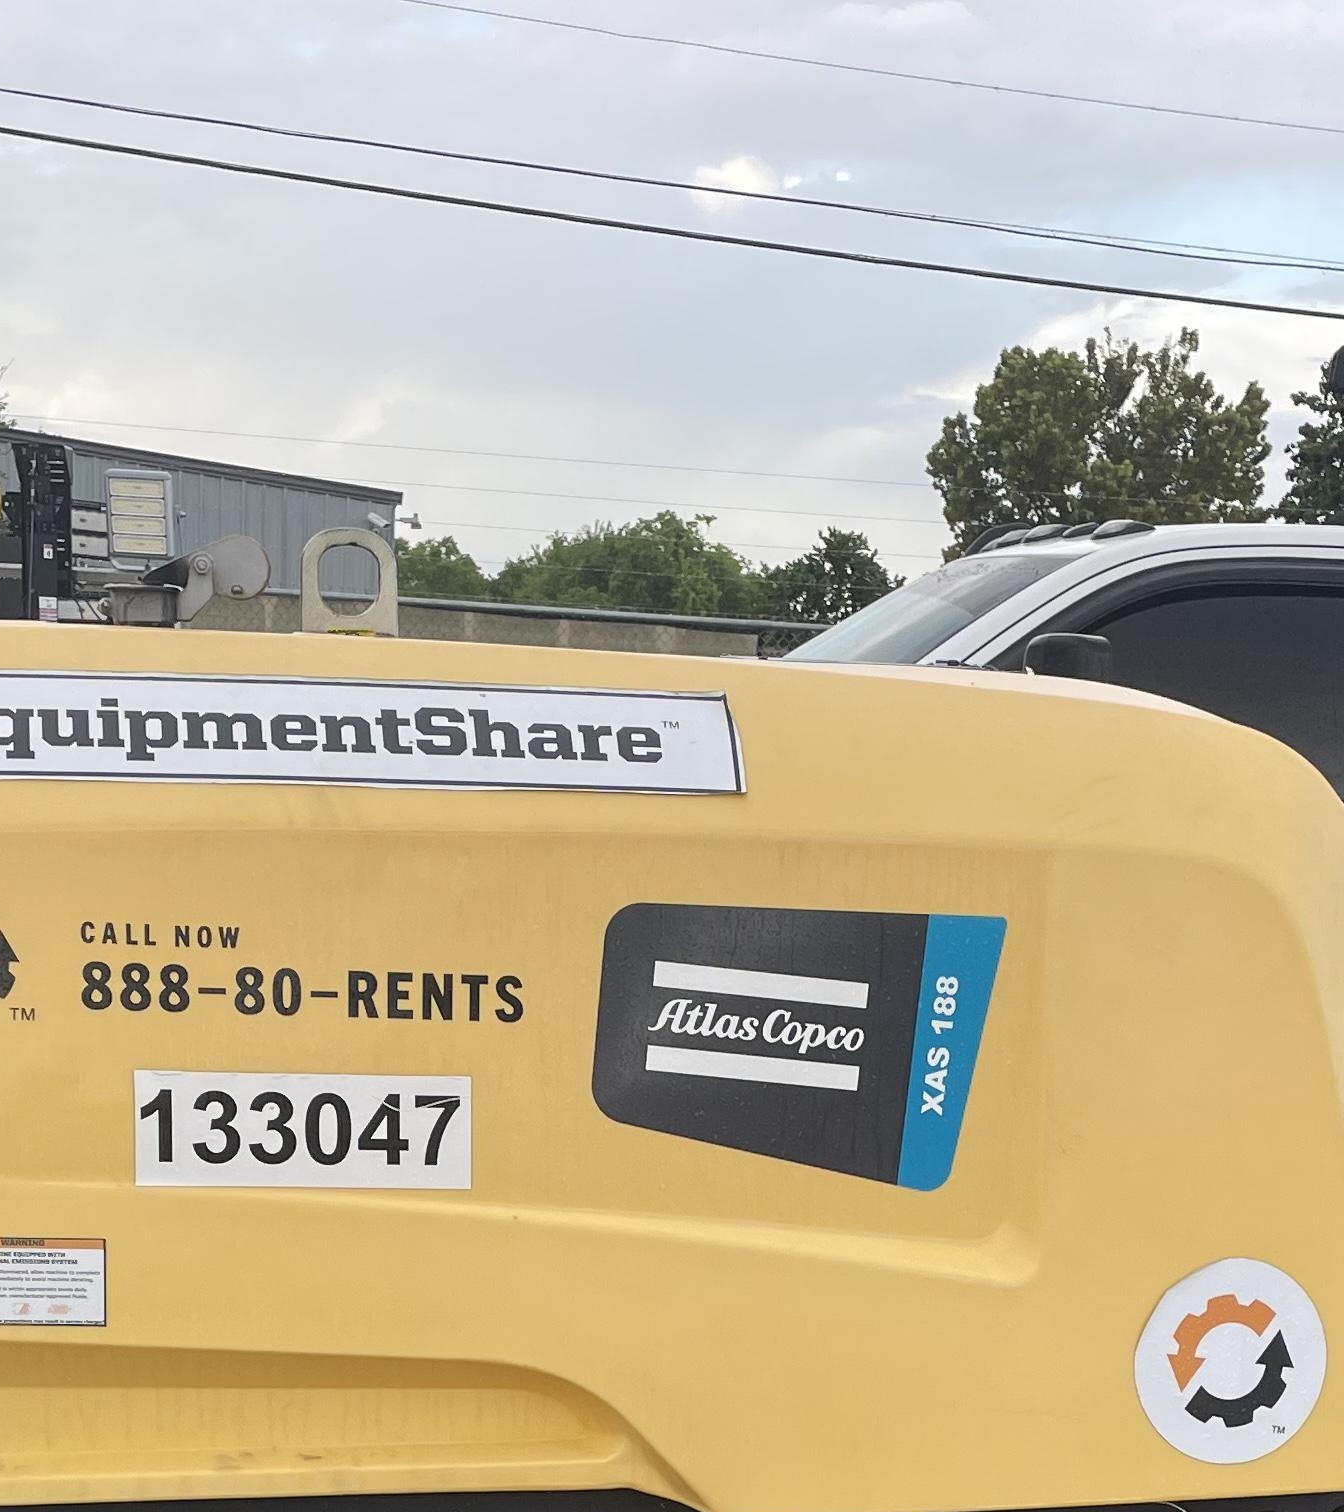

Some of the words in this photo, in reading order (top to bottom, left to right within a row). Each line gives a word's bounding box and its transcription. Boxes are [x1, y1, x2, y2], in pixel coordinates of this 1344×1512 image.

[80, 921, 157, 946] CALL
[174, 925, 240, 949] NOW
[81, 961, 524, 1023] 888-80-RENTS
[931, 976, 959, 1035] 188
[647, 998, 759, 1041] Atlas
[762, 1009, 865, 1054] Copco
[920, 1047, 950, 1116] XAS
[140, 1089, 461, 1166] 133047
